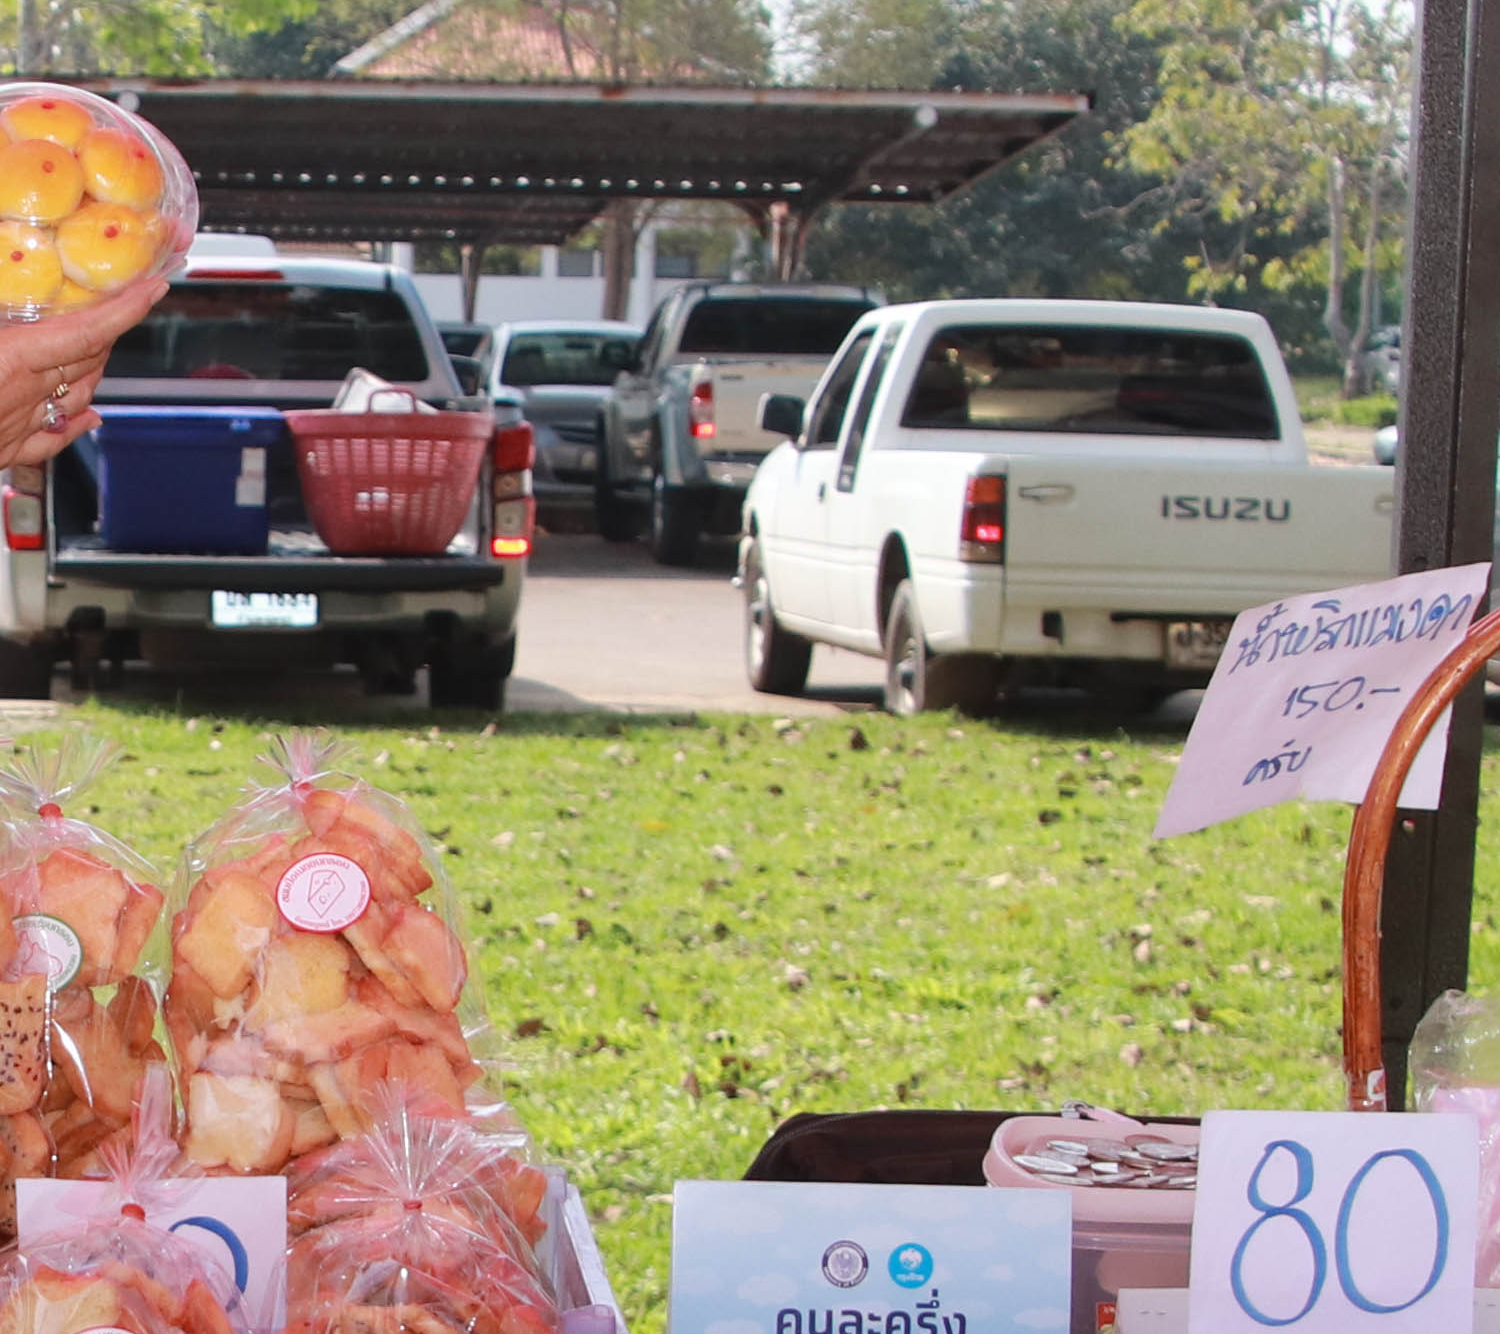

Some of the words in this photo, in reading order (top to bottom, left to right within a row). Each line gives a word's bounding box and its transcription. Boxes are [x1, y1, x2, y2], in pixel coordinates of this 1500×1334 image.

[1160, 494, 1292, 522] ISUZU
[1282, 675, 1402, 719] 150.-
[1228, 1139, 1452, 1329] 80
